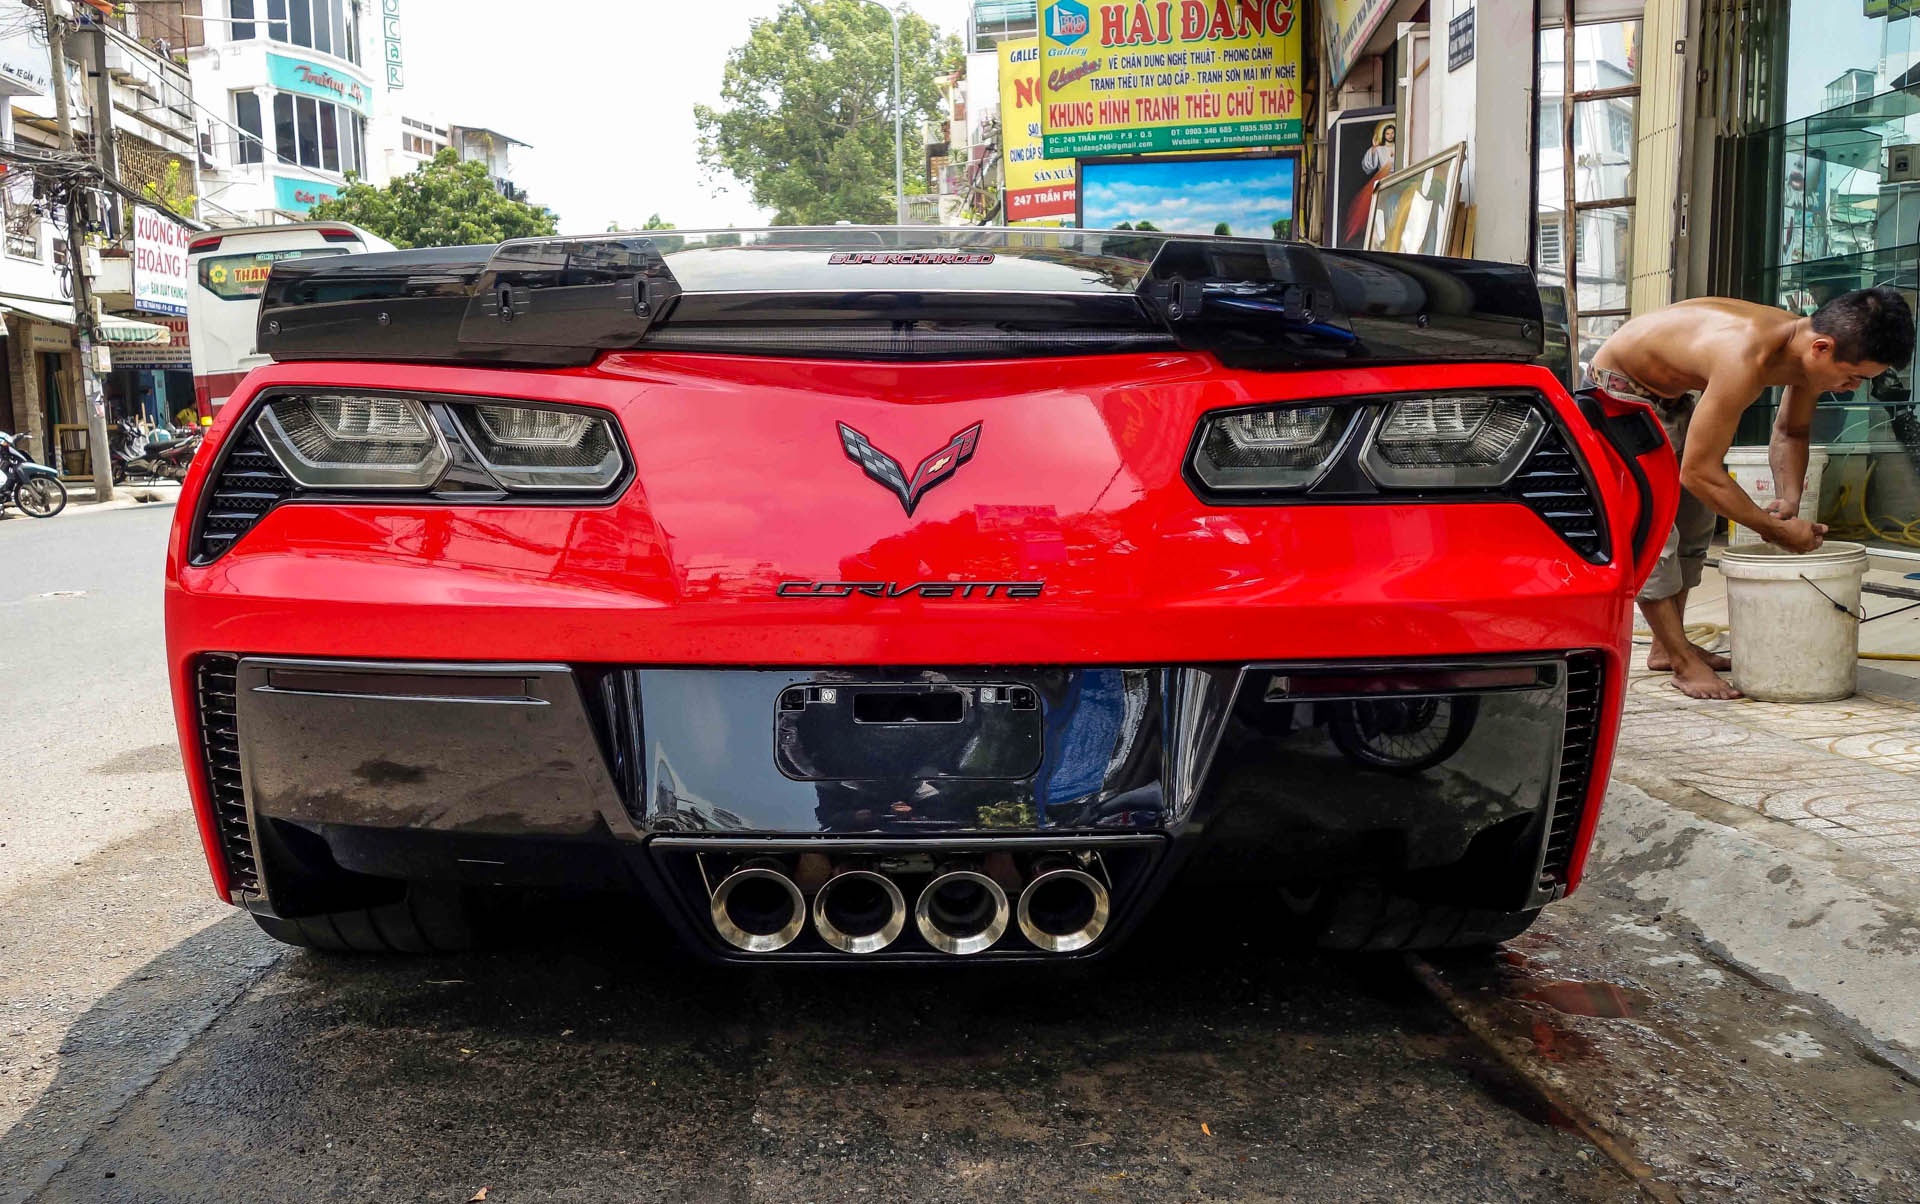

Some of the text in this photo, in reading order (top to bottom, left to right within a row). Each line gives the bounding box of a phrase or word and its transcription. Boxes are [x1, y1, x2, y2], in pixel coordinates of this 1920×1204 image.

[1010, 48, 1040, 62] GALLE
[1047, 47, 1088, 57] Gallery
[1144, 54, 1165, 68] DUNG
[1223, 47, 1250, 62] PHONG
[1090, 77, 1115, 91] TRANH
[1140, 74, 1155, 88] TAY
[1157, 73, 1172, 86] CAO
[1197, 69, 1223, 84] TRANH
[1049, 102, 1094, 128] KHUNG
[1136, 96, 1180, 122] TRANH
[1275, 122, 1288, 130] 317
[1054, 164, 1074, 179] XUẤ
[1013, 194, 1032, 206] 247
[1062, 190, 1076, 200] PH
[176, 225, 190, 249] KH
[829, 253, 995, 265] SUPERCHARGED
[776, 581, 1045, 597] CORVETTE
